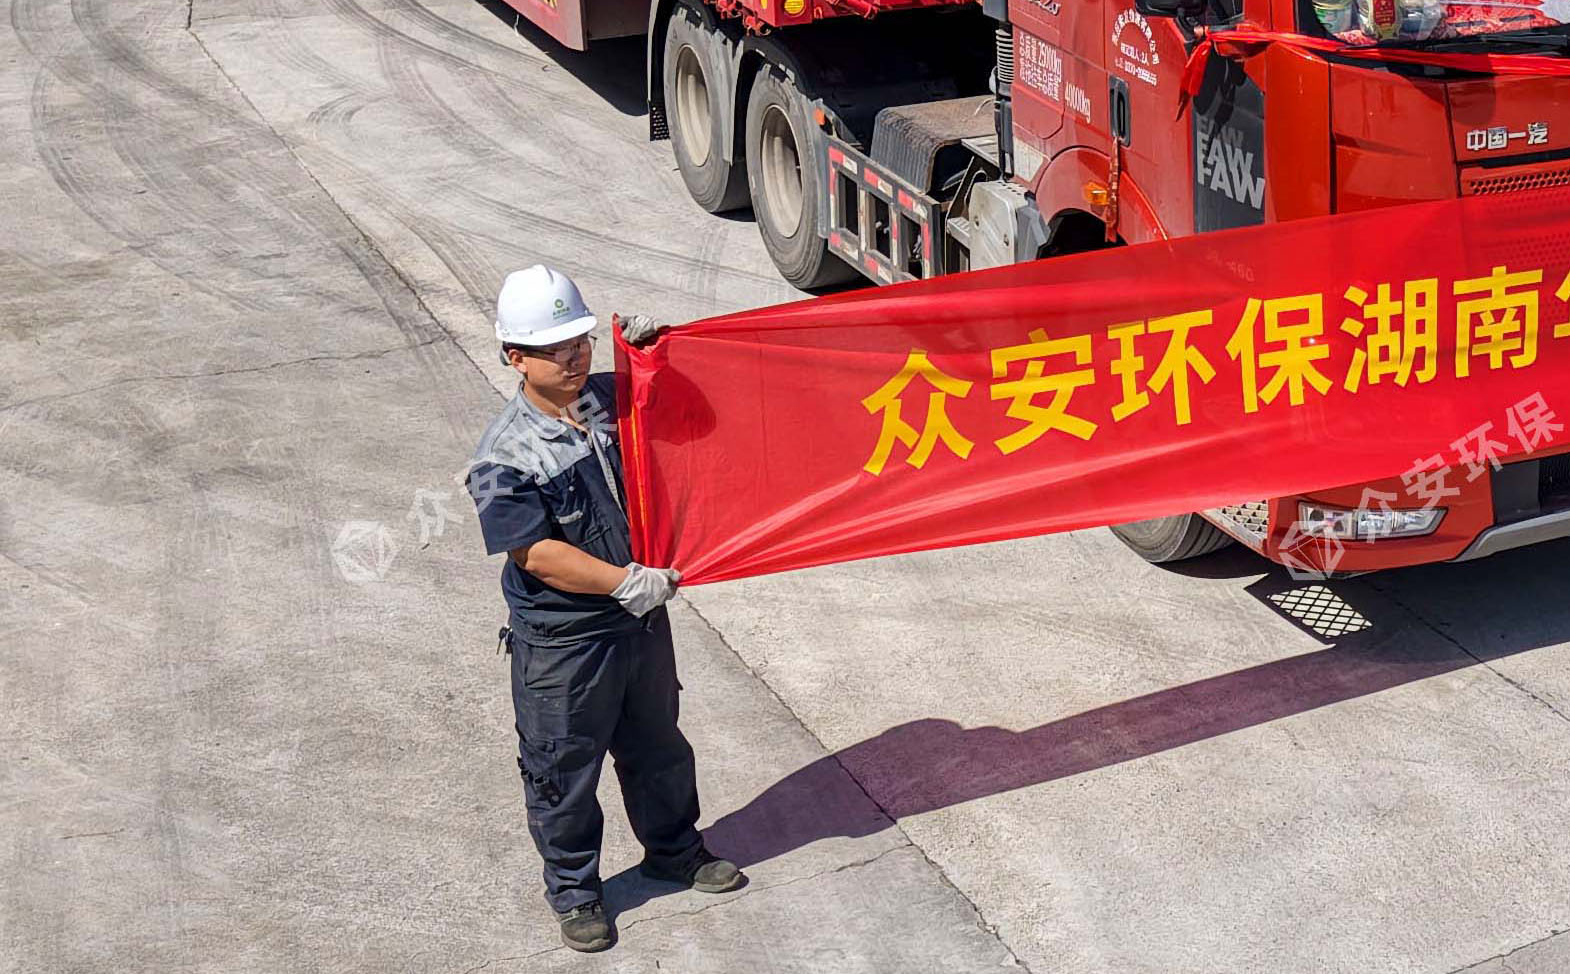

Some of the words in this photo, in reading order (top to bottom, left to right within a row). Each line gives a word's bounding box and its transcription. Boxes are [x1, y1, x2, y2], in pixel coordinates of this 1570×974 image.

[1466, 121, 1549, 151] 中国一汽
[1197, 133, 1266, 210] FAW
